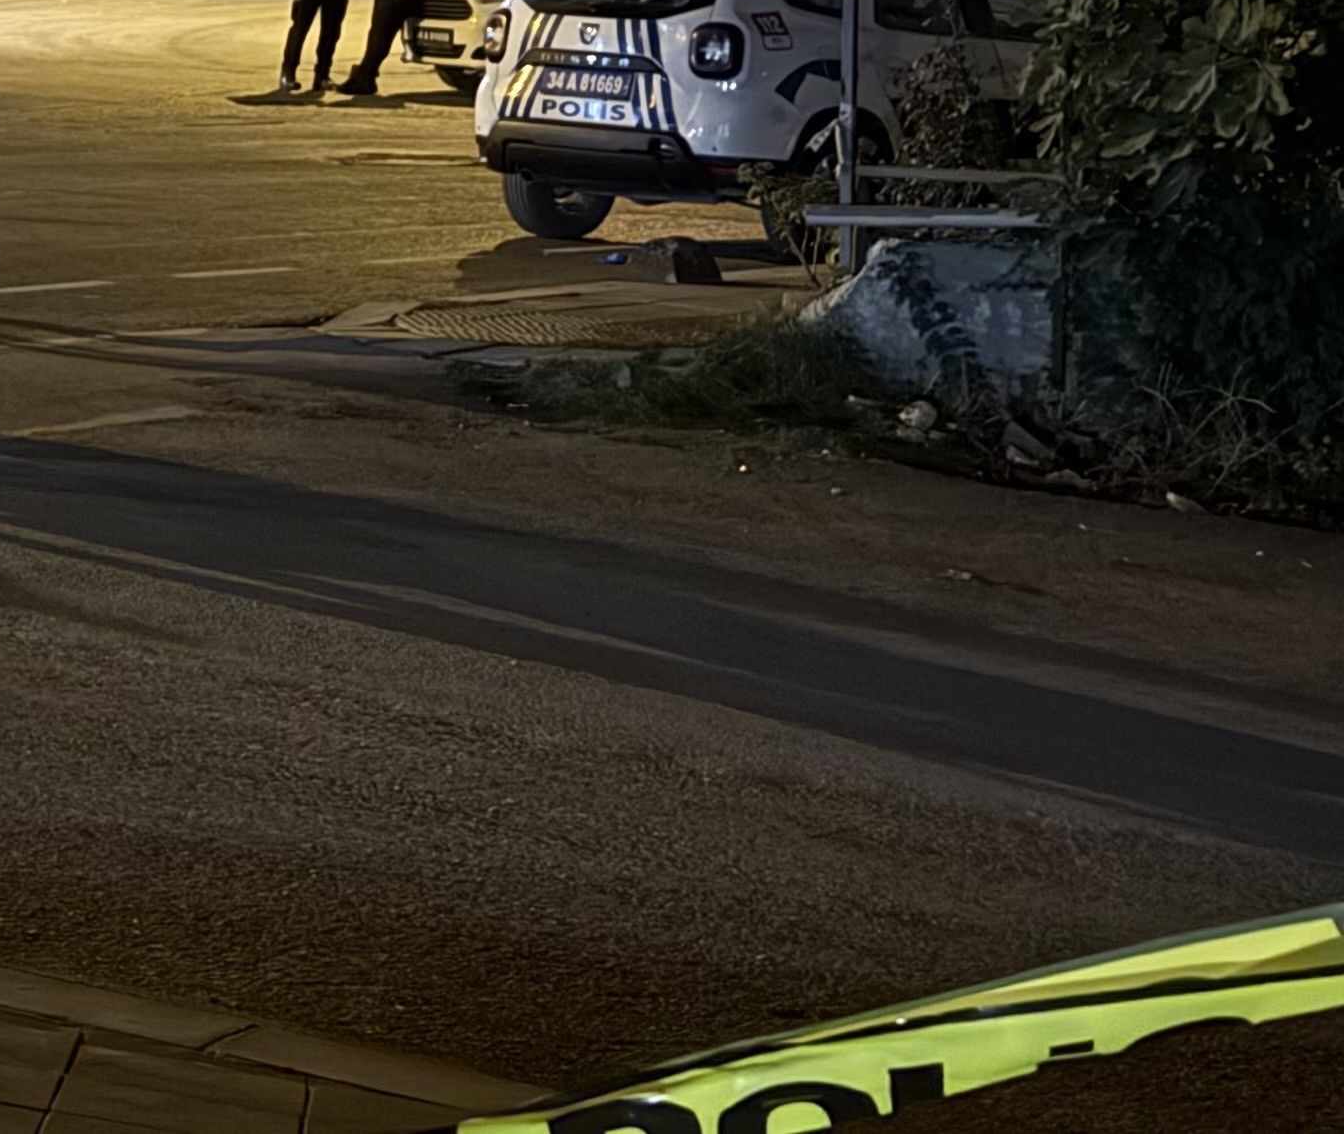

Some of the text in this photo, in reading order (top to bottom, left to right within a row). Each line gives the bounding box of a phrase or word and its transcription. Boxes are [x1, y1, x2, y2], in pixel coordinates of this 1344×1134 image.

[755, 15, 786, 34] 112
[546, 70, 624, 96] 34 A 81669
